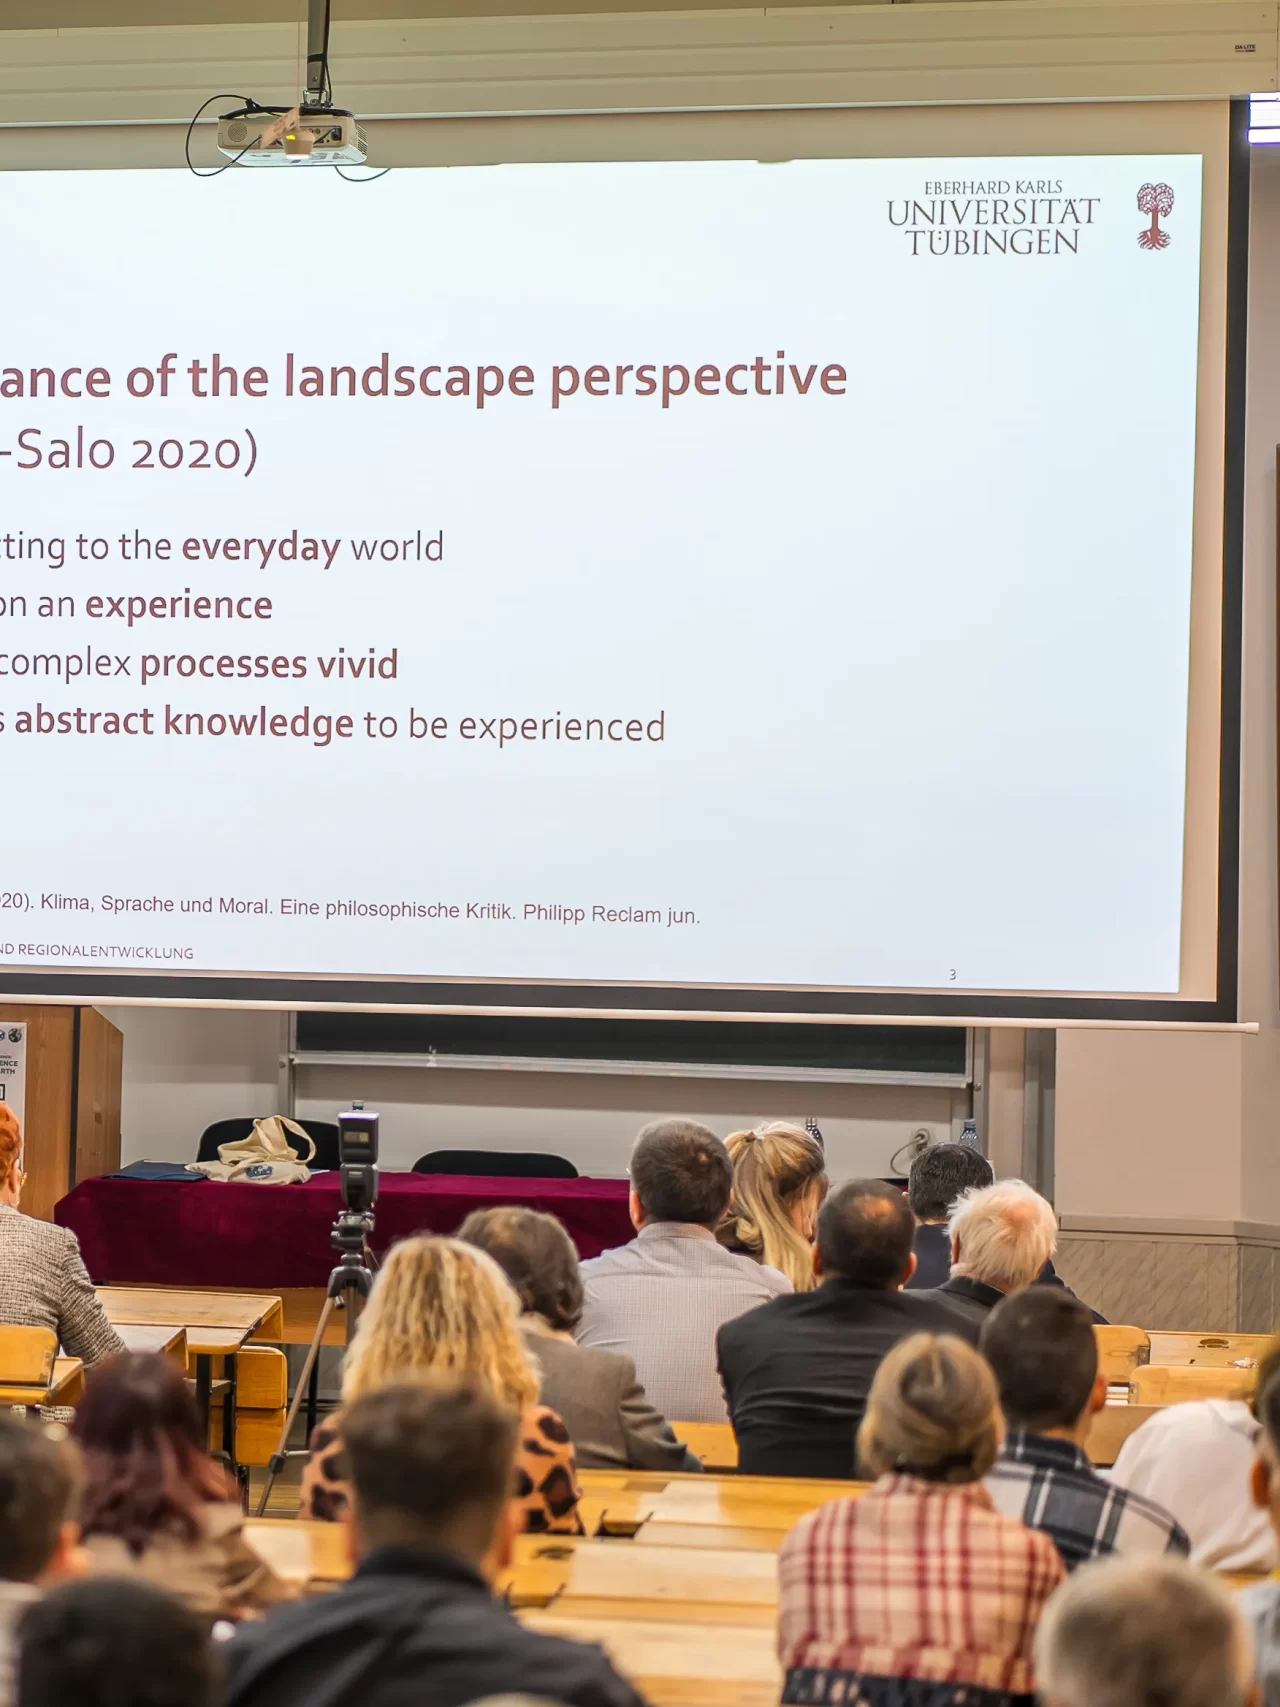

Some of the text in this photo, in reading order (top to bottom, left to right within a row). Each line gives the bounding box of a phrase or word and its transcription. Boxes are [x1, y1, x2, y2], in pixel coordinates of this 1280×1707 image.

[924, 180, 1063, 195] EBERHARD KARLS
[887, 198, 1101, 226] UNIVERSITÄT
[904, 229, 1080, 255] TÜBINGEN
[126, 353, 178, 398] of
[186, 353, 269, 398] the
[286, 353, 535, 409] landscape
[551, 350, 847, 409] perspective
[131, 428, 257, 478] 2020)
[75, 533, 109, 560] to
[117, 529, 172, 561] the
[182, 530, 342, 571] everyday
[350, 530, 443, 562] world
[37, 597, 75, 618] an
[85, 588, 273, 627] experience
[141, 655, 308, 686] processes
[316, 648, 398, 680] vivid
[14, 703, 155, 736] abstract
[164, 704, 354, 747] knowledge
[363, 711, 398, 739] to
[409, 707, 448, 739] be
[459, 709, 665, 749] experienced
[41, 893, 95, 914] Klima,
[100, 894, 175, 915] Sprache
[180, 896, 213, 913] und
[219, 898, 273, 915] Moral.
[280, 899, 320, 916] Eine
[325, 899, 460, 922] philosophische
[466, 902, 516, 920] Kritik.
[523, 903, 586, 926] Philipp
[592, 905, 662, 924] Reclam
[666, 906, 700, 928] jun.
[18, 944, 194, 960] REGIONALENTWICKLUNG
[949, 968, 957, 981] 3
